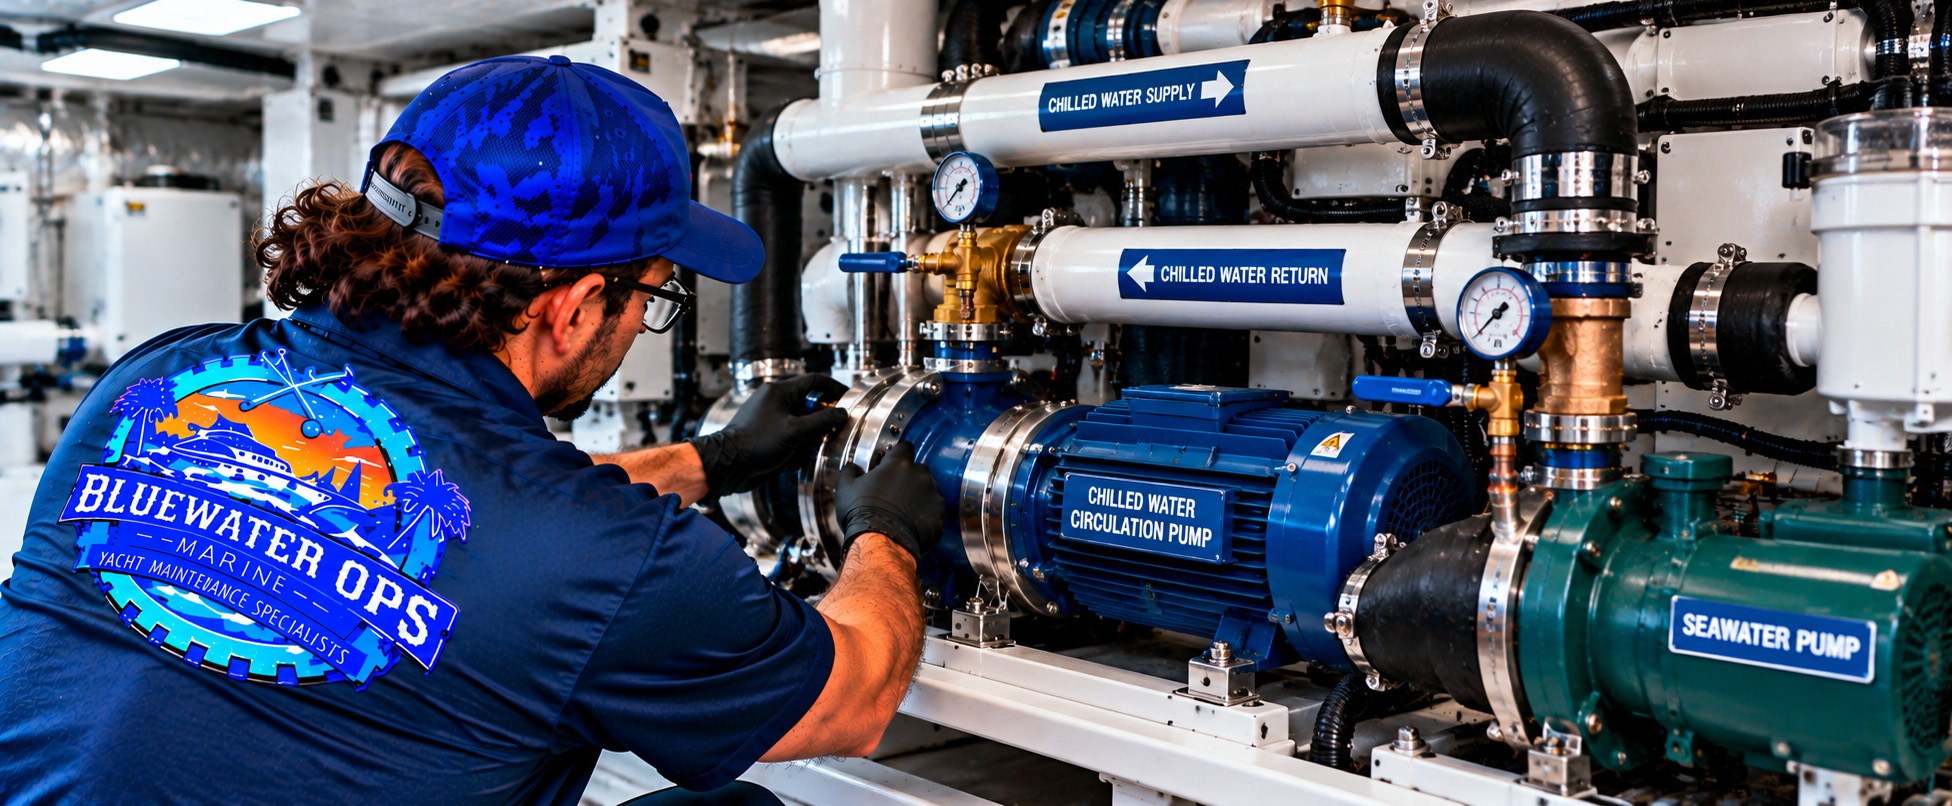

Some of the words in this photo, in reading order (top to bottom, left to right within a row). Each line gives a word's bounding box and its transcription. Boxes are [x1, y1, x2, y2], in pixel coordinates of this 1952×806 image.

[1048, 94, 1097, 113] CHILLED
[1101, 89, 1142, 108] WATER
[1146, 83, 1196, 104] SUPPLY
[1160, 265, 1215, 283] CHILLED
[1220, 266, 1266, 284] WATER
[1271, 267, 1329, 285] RETURN
[1088, 486, 1144, 511] CHILLED
[1148, 493, 1196, 519] WATER
[1070, 509, 1165, 541] CIRCULATION
[1168, 523, 1213, 548] PUMP
[74, 472, 325, 580] BLUEWATER
[335, 559, 439, 648] OPS
[176, 537, 286, 594] MARINE
[99, 551, 145, 574] YACHT
[251, 600, 350, 665] SPECIALISTS
[1682, 612, 1790, 651] SEAWATER
[1795, 628, 1861, 661] PUMP
